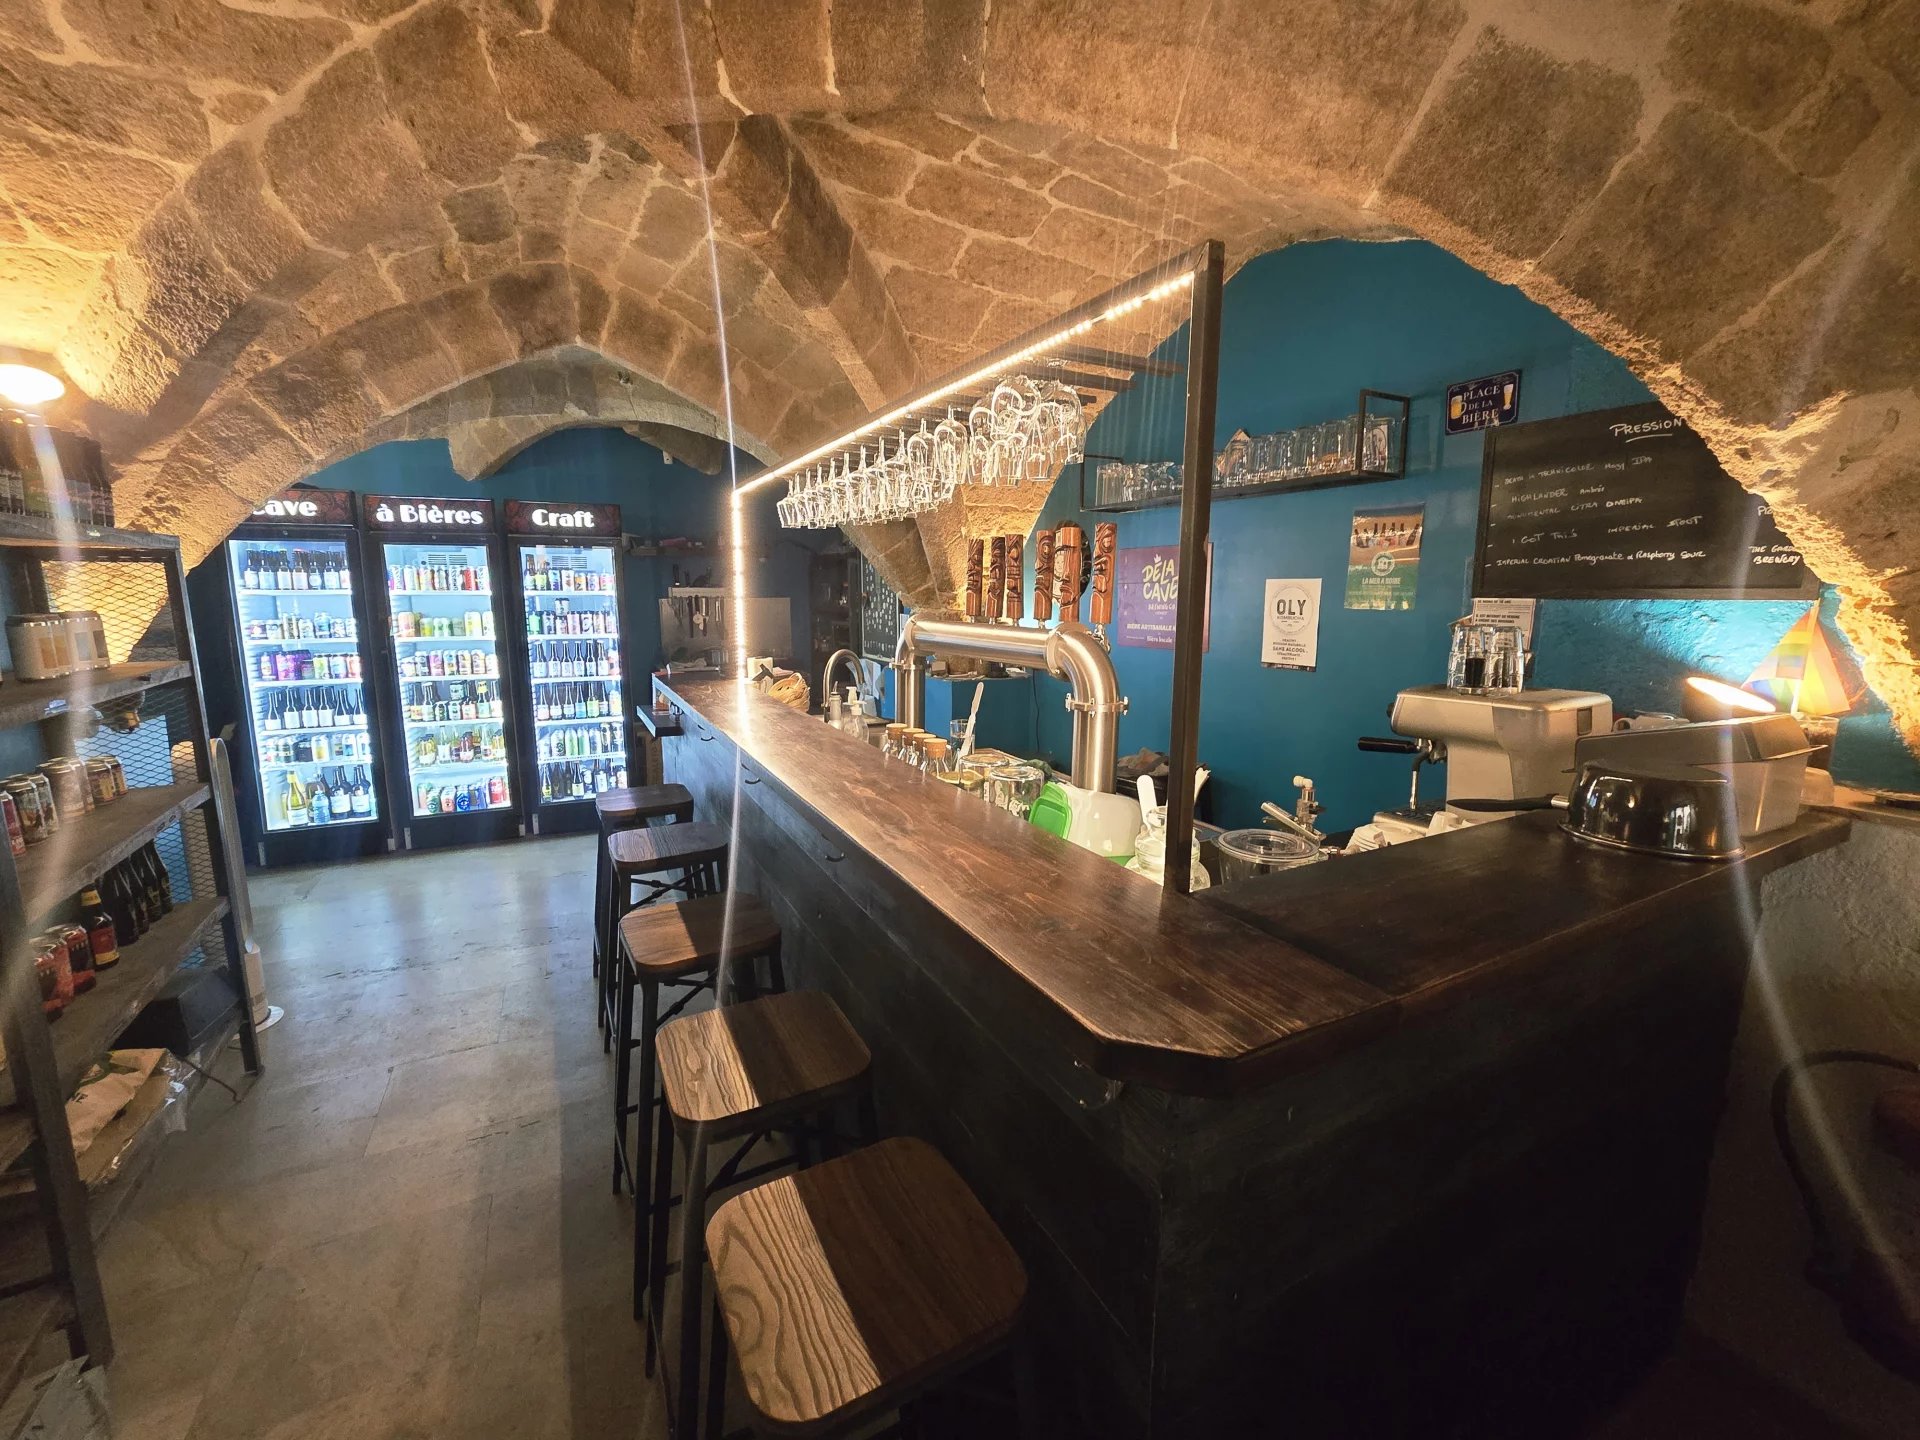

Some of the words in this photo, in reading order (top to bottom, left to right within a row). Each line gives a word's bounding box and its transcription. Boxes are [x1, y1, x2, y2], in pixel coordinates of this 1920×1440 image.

[1463, 385, 1500, 401] PLACE
[1468, 401, 1480, 411] DE
[1482, 399, 1493, 408] LA
[1462, 408, 1499, 425] BIÈRE
[375, 503, 395, 523] à
[399, 505, 484, 525] Bières
[531, 508, 595, 528] Craft
[1635, 550, 1676, 561] Raspberry
[1143, 576, 1178, 603] CAVE
[1276, 599, 1307, 616] OLY
